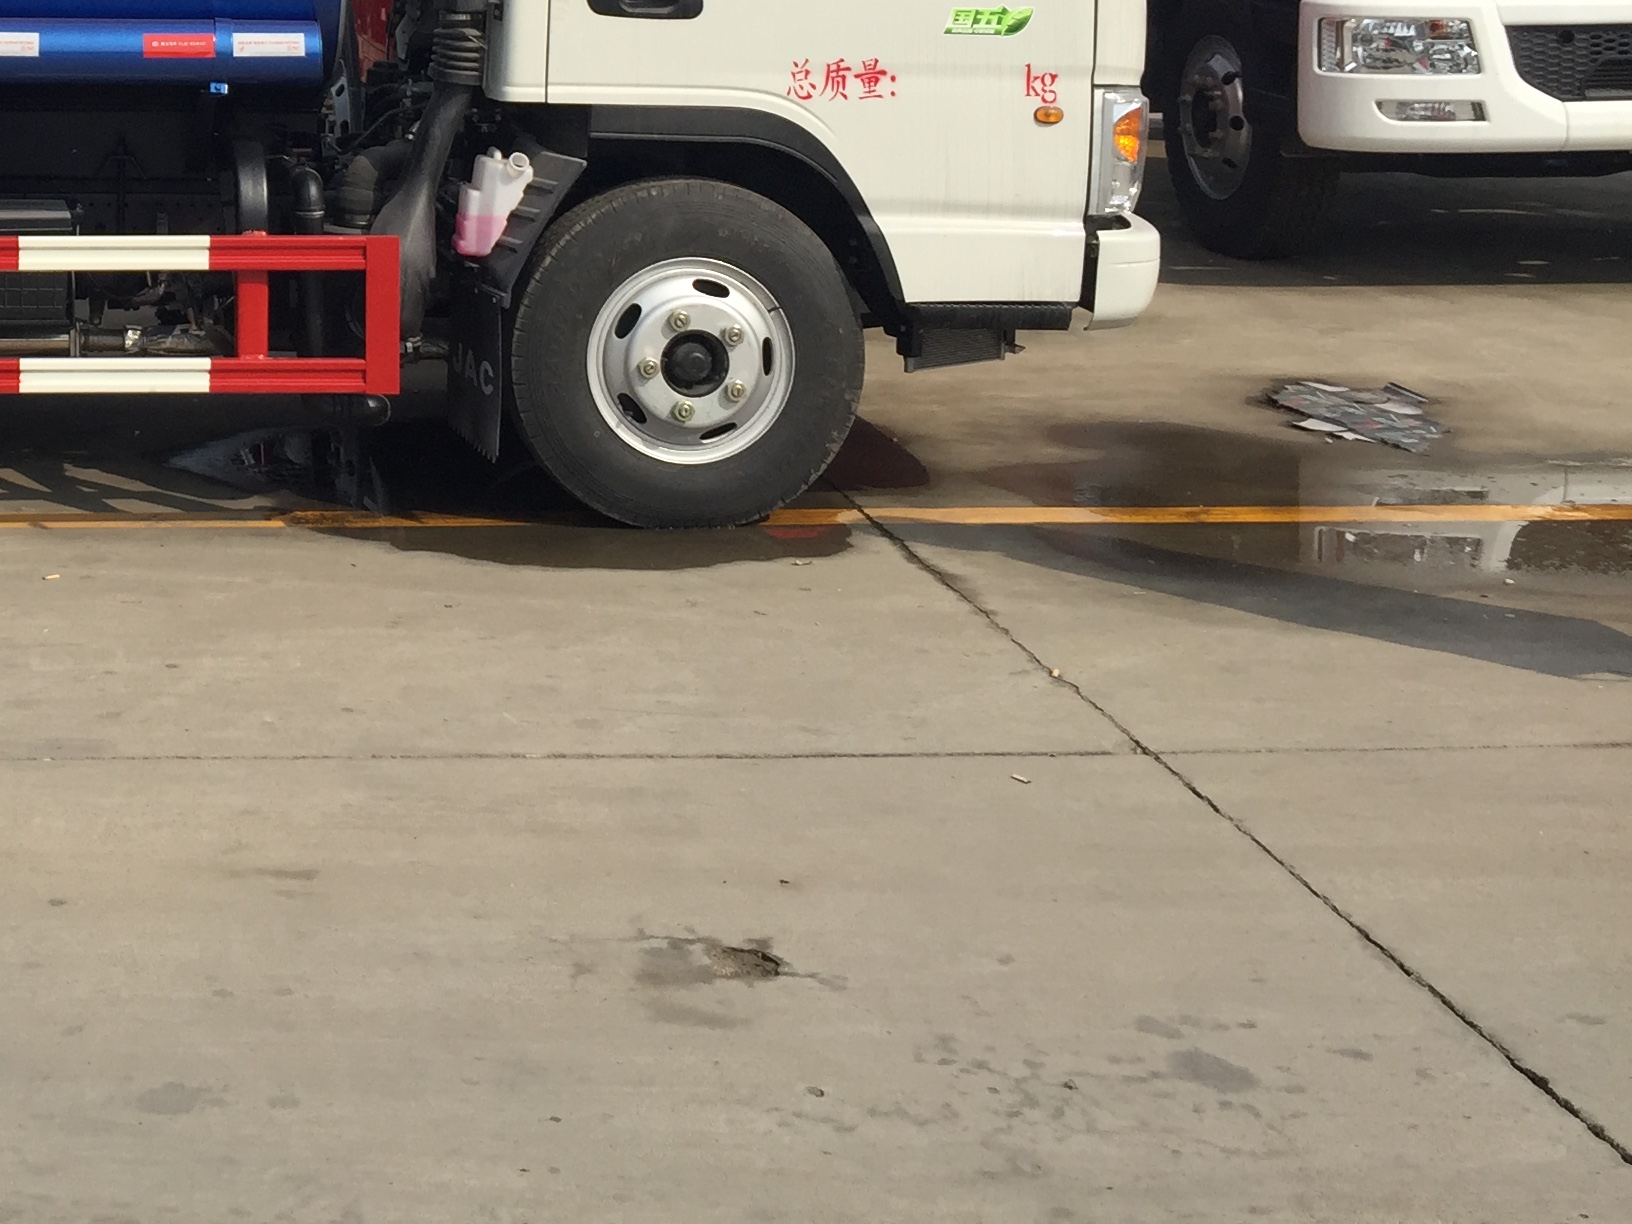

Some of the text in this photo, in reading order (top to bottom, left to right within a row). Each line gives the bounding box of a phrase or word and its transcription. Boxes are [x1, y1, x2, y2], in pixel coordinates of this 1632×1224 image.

[947, 6, 1008, 28] 国五
[785, 57, 1059, 104] 总质量: kg
[452, 342, 494, 395] JAC
